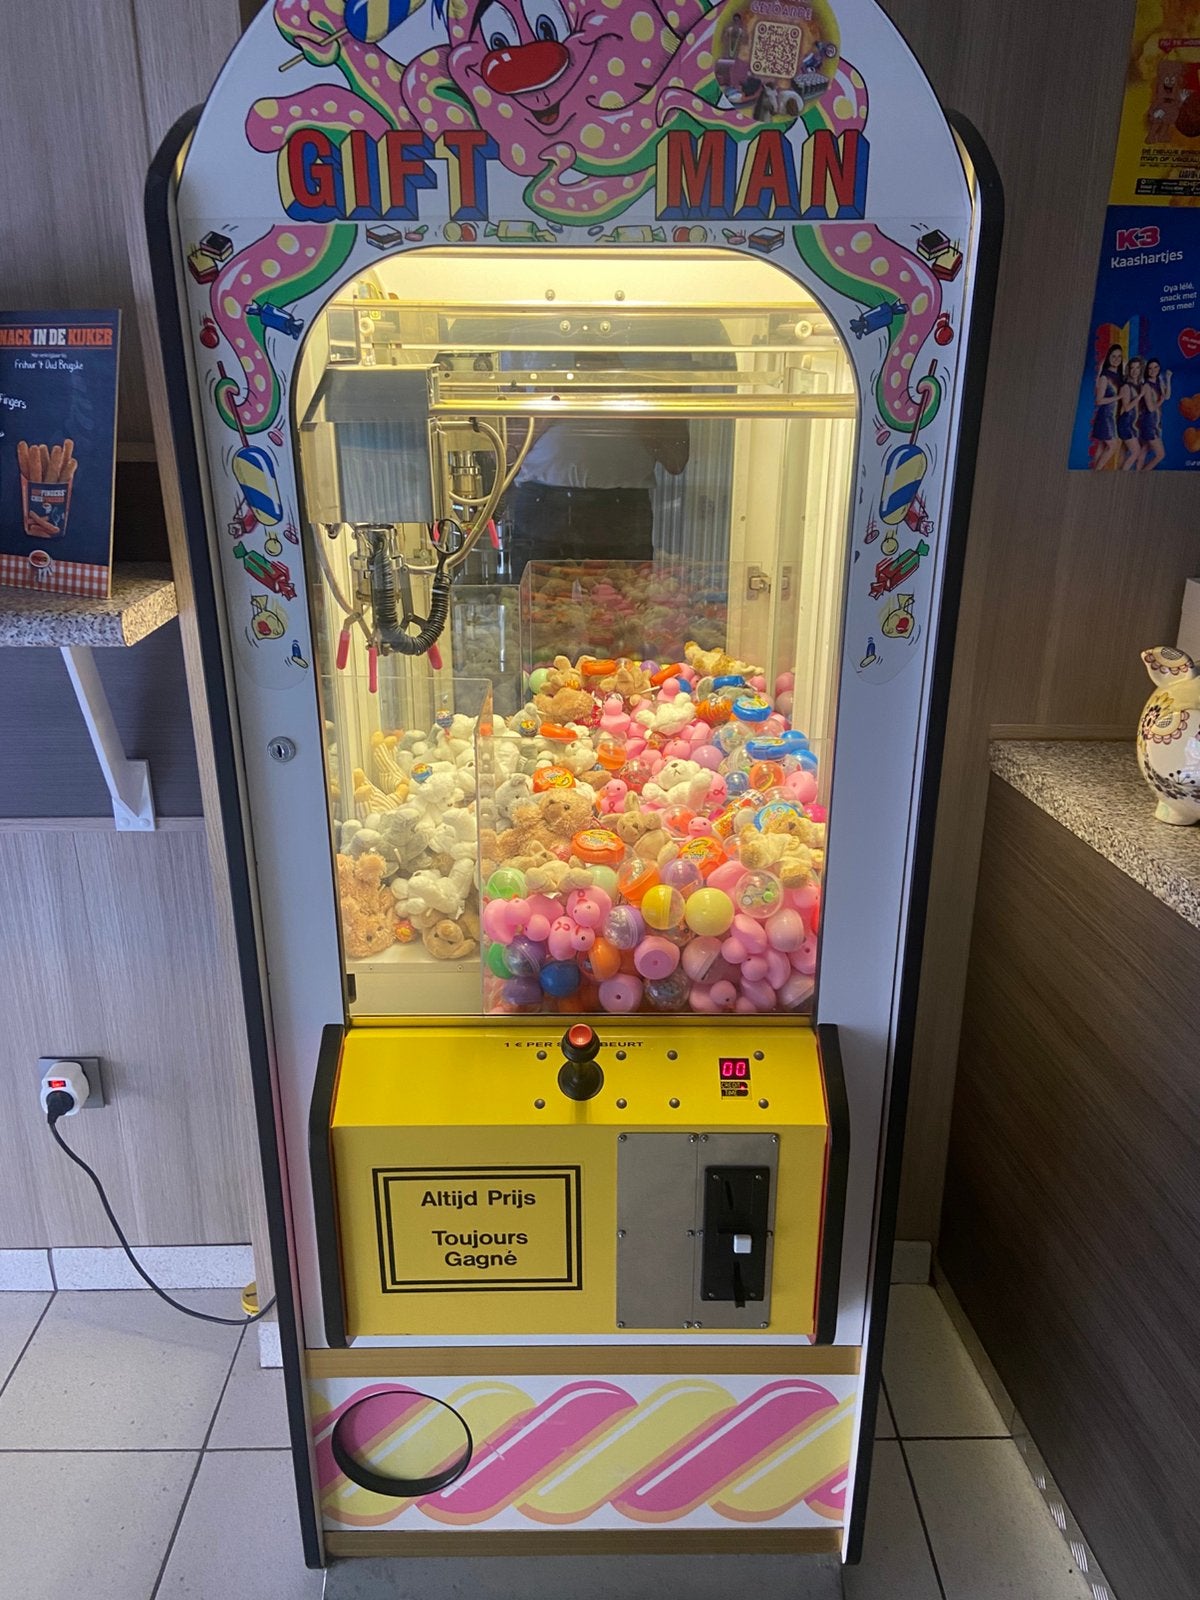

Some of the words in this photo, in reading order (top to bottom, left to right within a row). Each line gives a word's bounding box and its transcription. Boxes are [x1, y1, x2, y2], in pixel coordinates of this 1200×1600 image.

[278, 129, 500, 221] GIFT
[655, 129, 869, 220] MAN
[1116, 226, 1160, 251] K3
[1111, 250, 1184, 269] Kaashartjes
[1160, 293, 1181, 303] snack
[1163, 285, 1178, 293] Oya
[1161, 304, 1175, 312] ons
[1176, 301, 1195, 310] mee!
[33, 328, 47, 346] IN
[49, 328, 66, 346] DE
[527, 1040, 553, 1048] PER
[722, 1061, 746, 1077] 00
[421, 1190, 478, 1209] Altijd
[488, 1189, 536, 1208] Prijs
[432, 1230, 528, 1248] Toujours
[444, 1249, 518, 1269] Gagné
